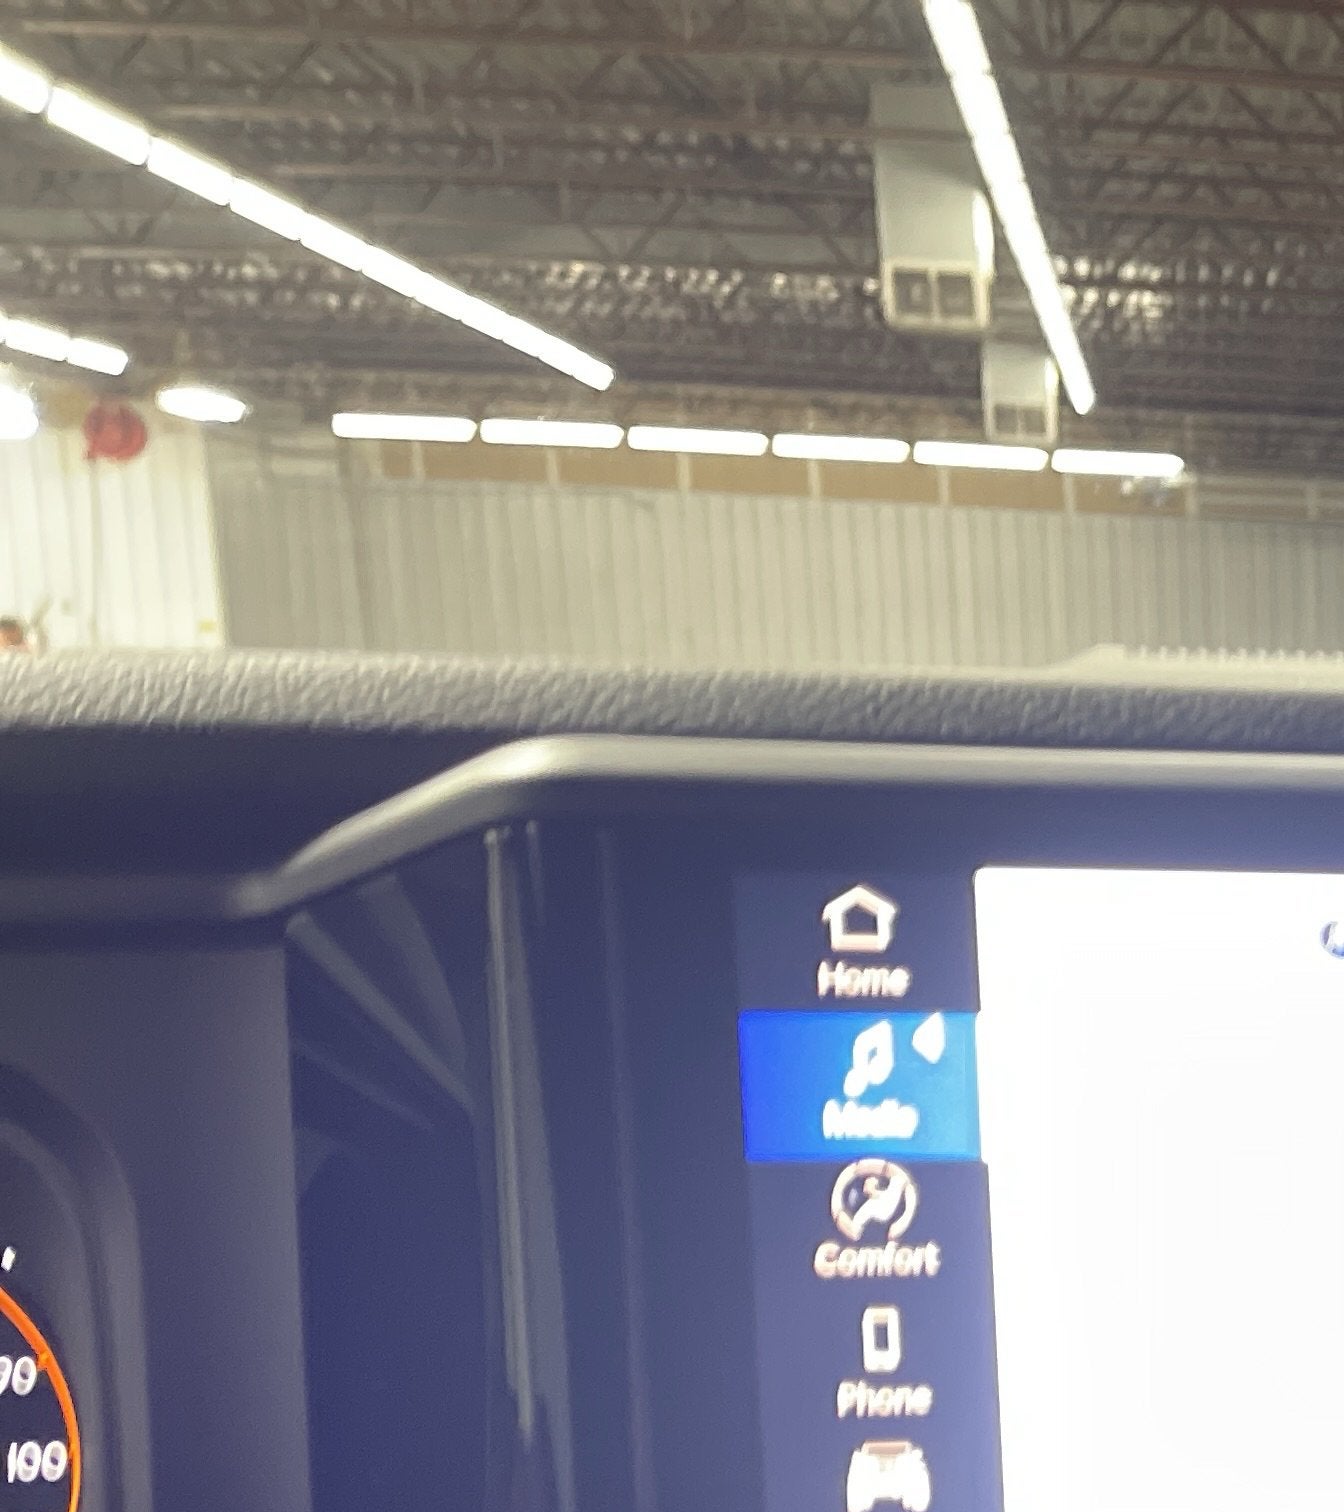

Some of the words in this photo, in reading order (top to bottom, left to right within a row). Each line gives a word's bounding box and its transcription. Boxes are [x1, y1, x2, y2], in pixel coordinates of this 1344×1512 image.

[816, 961, 912, 999] Home
[813, 1240, 942, 1279] Comfort
[836, 1380, 934, 1419] Phone
[7, 1439, 69, 1484] 100
